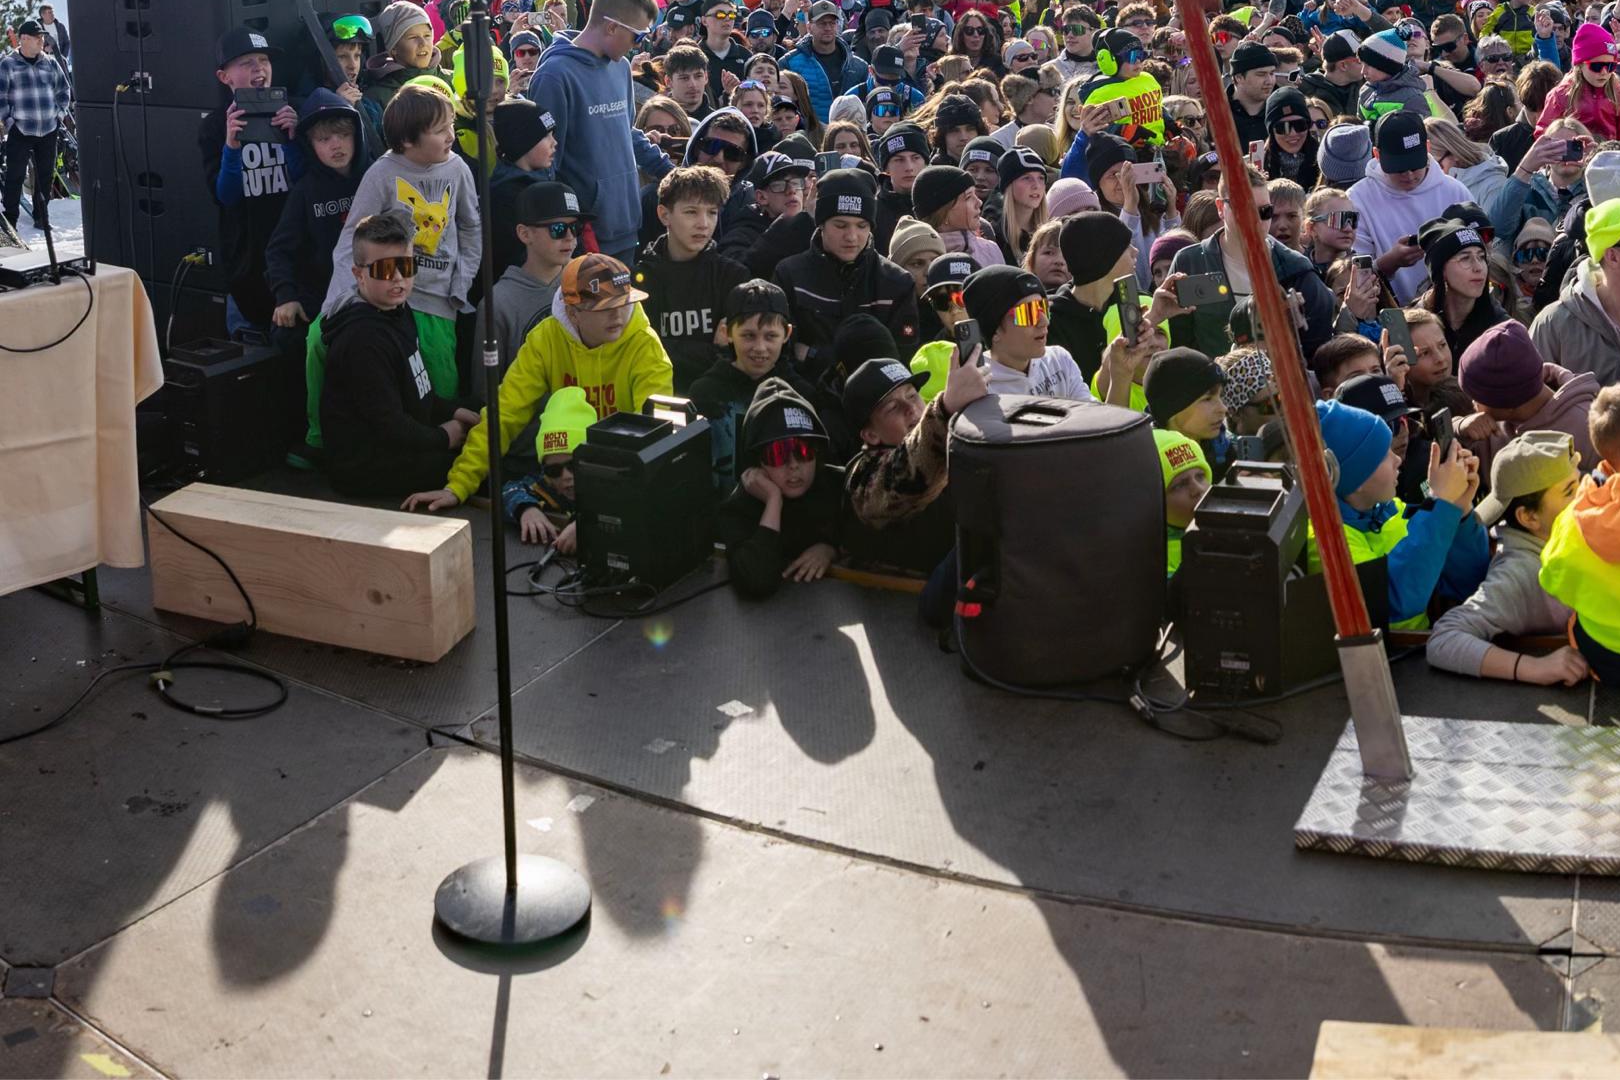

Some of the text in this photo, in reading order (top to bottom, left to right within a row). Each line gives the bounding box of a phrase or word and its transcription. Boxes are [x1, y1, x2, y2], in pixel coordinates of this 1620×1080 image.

[589, 101, 627, 115] DORFLEGEN
[241, 141, 285, 170] OLT
[838, 195, 862, 204] MOLTO
[838, 202, 862, 212] BRUTALE
[544, 432, 567, 441] MOLTO
[544, 440, 568, 450] BRUTALE
[1166, 444, 1191, 458] MOLTO
